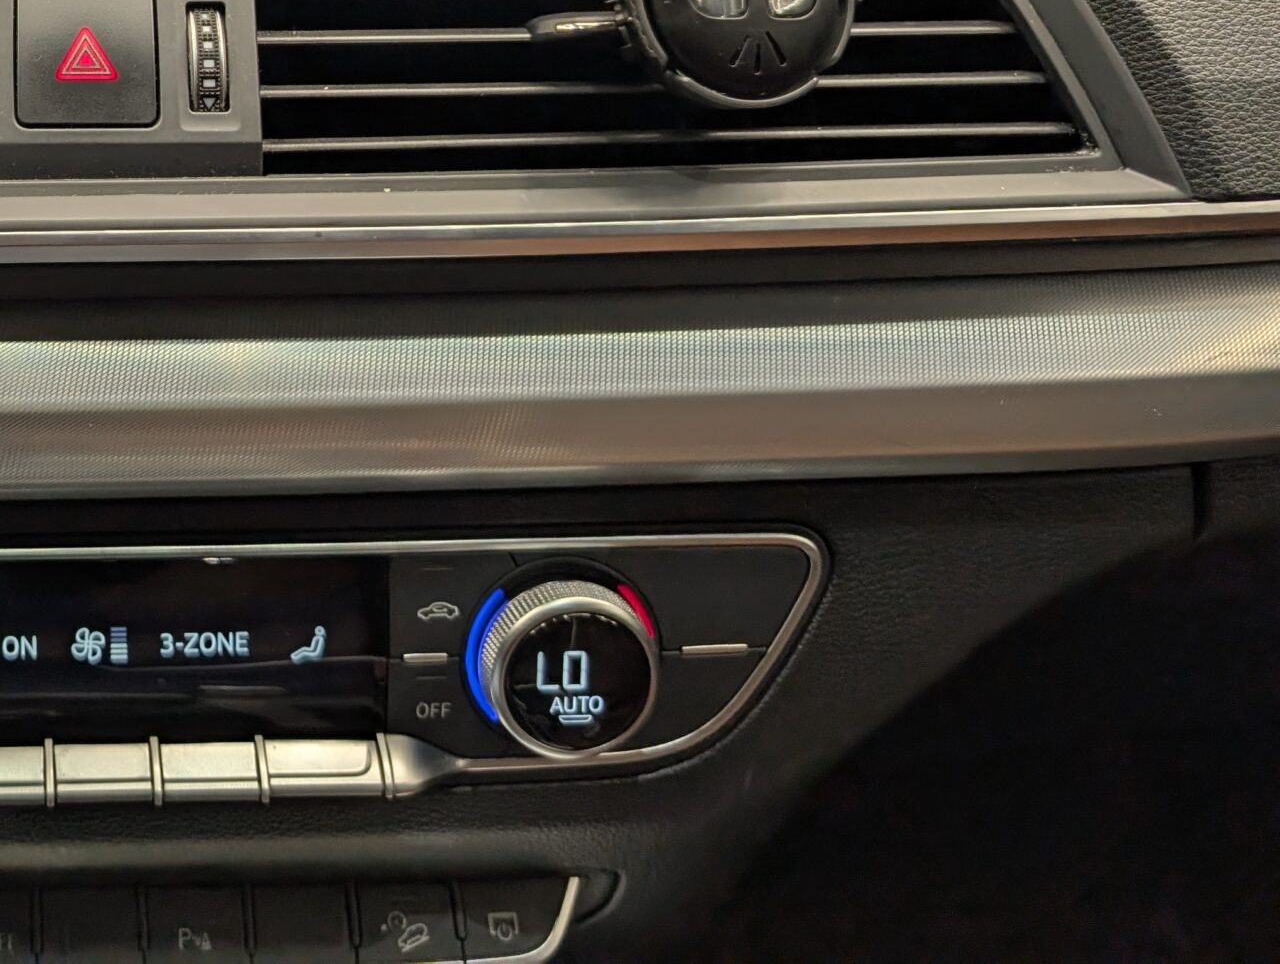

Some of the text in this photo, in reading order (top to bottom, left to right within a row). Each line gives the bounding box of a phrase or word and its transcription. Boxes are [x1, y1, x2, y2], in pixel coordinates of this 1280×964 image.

[1, 635, 38, 661] ON
[159, 631, 250, 658] 3-ZONE
[536, 650, 589, 691] LO
[415, 702, 452, 719] OFF
[549, 695, 605, 714] AUTO
